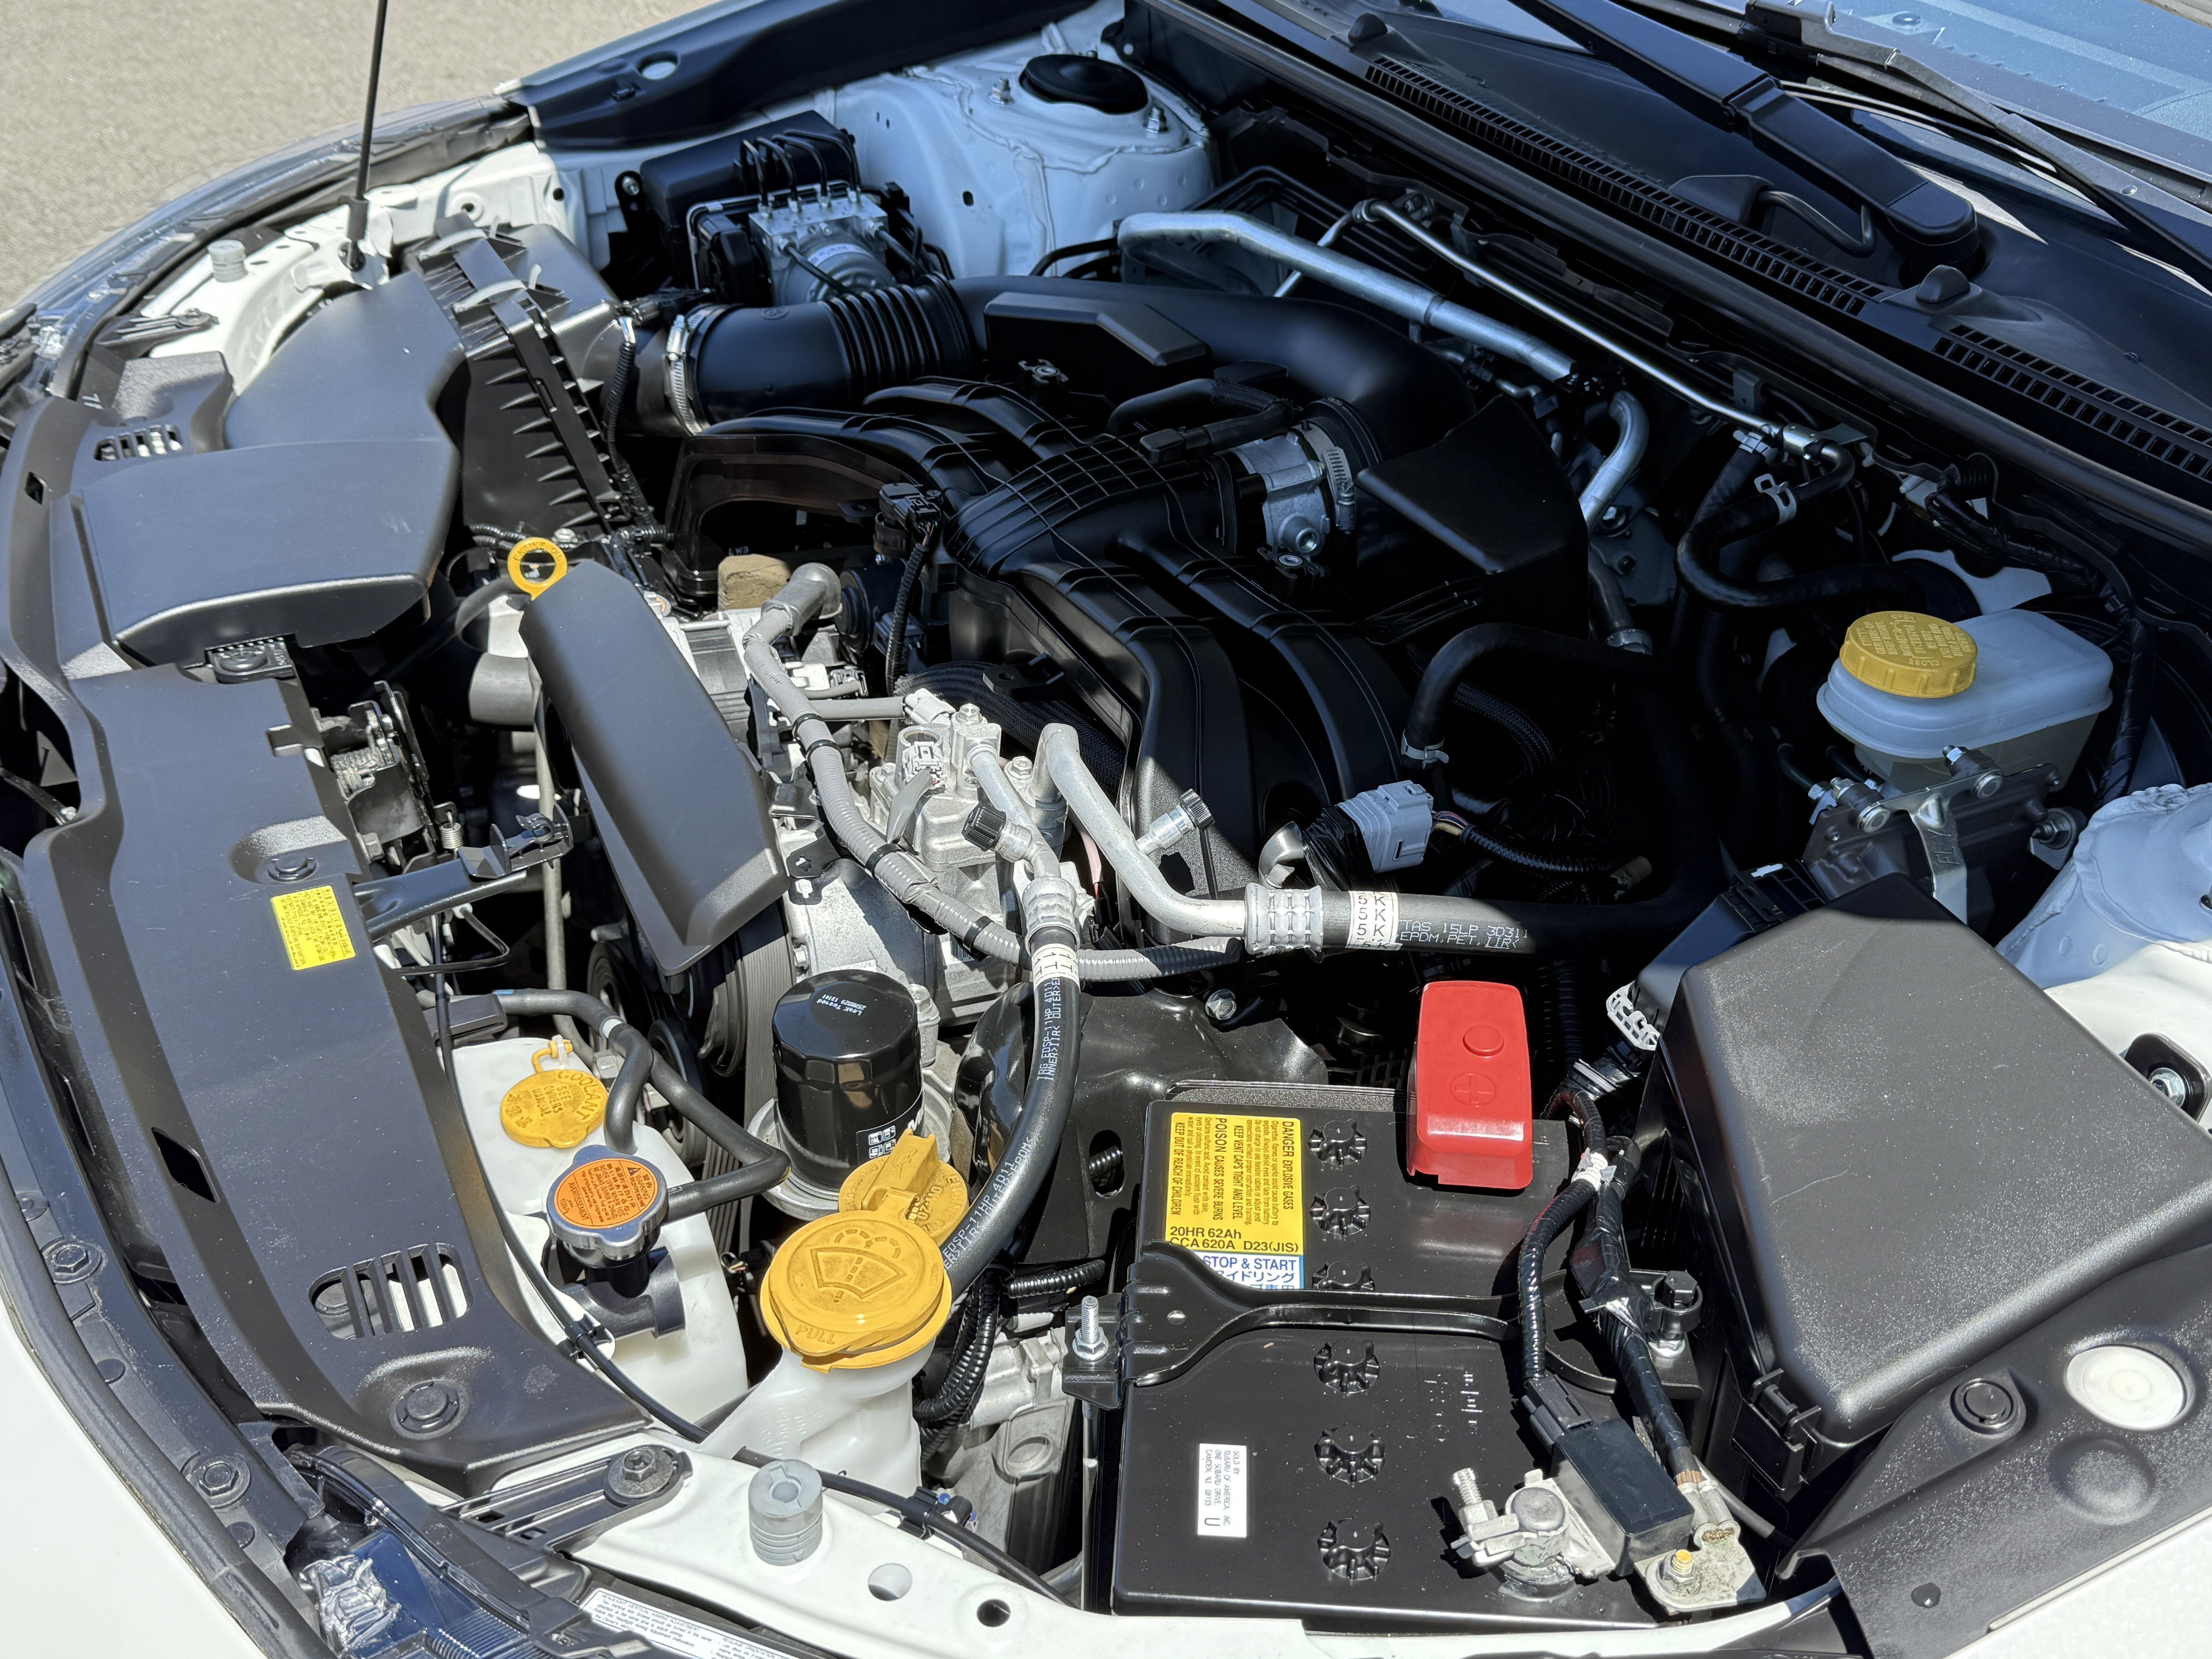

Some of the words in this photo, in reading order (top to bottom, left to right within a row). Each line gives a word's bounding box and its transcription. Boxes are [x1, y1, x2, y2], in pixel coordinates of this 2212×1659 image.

[551, 548, 562, 561] OIL
[1358, 895, 1368, 905] 5
[1374, 896, 1386, 906] K
[1358, 907, 1368, 920] 5
[1375, 909, 1386, 922] K
[1357, 924, 1367, 936] 5
[1374, 924, 1384, 937] K
[1399, 920, 1431, 932] TAS
[816, 998, 842, 1010] Tested
[842, 1006, 862, 1016] Leak
[1037, 1061, 1048, 1080] IRG
[557, 1084, 572, 1102] SEE
[558, 1070, 601, 1120] COOLANT
[1174, 1122, 1185, 1135] KEEP
[1214, 1118, 1228, 1152] POISON
[1233, 1125, 1245, 1139] KEEP
[1173, 1136, 1185, 1148] OUT
[1233, 1139, 1245, 1154] VENT
[1280, 1121, 1295, 1157] DANGER
[1173, 1149, 1184, 1157] OF
[1172, 1158, 1183, 1176] REACH
[1213, 1155, 1225, 1177] CAUSES
[1233, 1154, 1244, 1170] CAPS
[1172, 1177, 1182, 1185] OF
[1232, 1171, 1244, 1187] TIGHT
[1281, 1160, 1295, 1190] EXPLOSIVE
[634, 1174, 651, 1200] WARNING
[1212, 1178, 1224, 1199] SEVERE
[1232, 1188, 1243, 1201] AND
[567, 1181, 589, 1221] AVERTISSEMENT
[916, 1185, 942, 1221] 0W-20
[1170, 1186, 1182, 1215] CHILDREN
[1282, 1191, 1294, 1210] GASES
[1212, 1200, 1224, 1221] BURNS
[1231, 1201, 1243, 1220] LEVEL
[1170, 1226, 1205, 1237] 20HR
[1208, 1229, 1242, 1239] 62Ah
[1202, 1239, 1236, 1250] 620A
[1244, 1241, 1298, 1252] D23(JIS)
[1202, 1255, 1237, 1268] STOP
[1241, 1258, 1250, 1269] &
[1254, 1258, 1297, 1271] START
[795, 1324, 835, 1345] PULL
[1204, 1517, 1221, 1526] U
